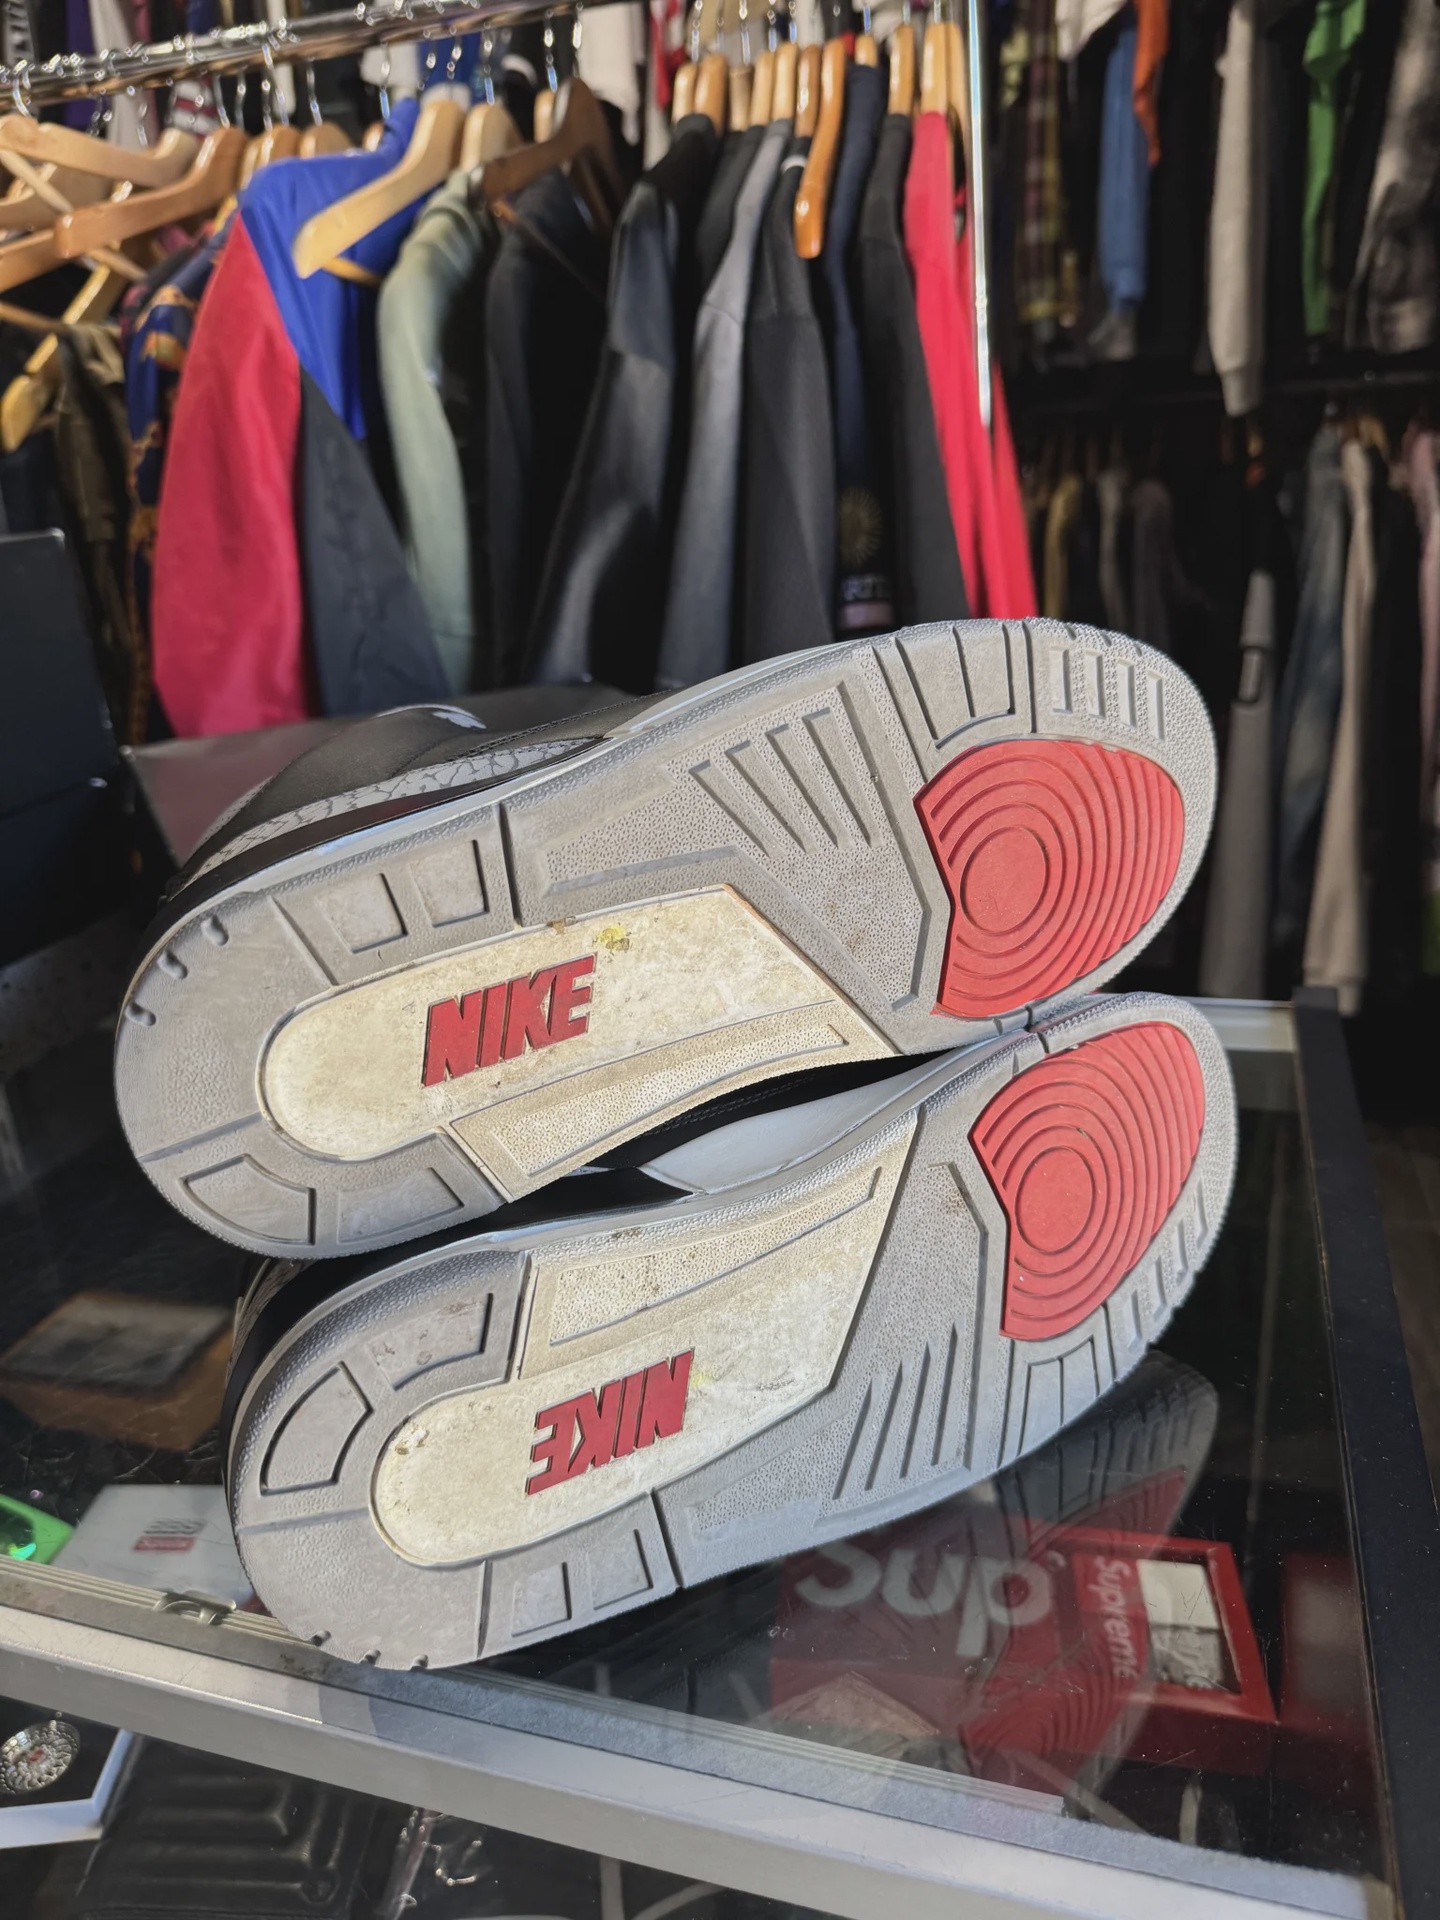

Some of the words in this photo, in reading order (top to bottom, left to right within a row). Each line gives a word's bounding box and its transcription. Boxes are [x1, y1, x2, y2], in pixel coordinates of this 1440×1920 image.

[422, 953, 597, 1087] NIKE
[526, 1348, 694, 1496] NIKE
[795, 1539, 1065, 1657] Sup
[1086, 1555, 1139, 1679] Supreme
